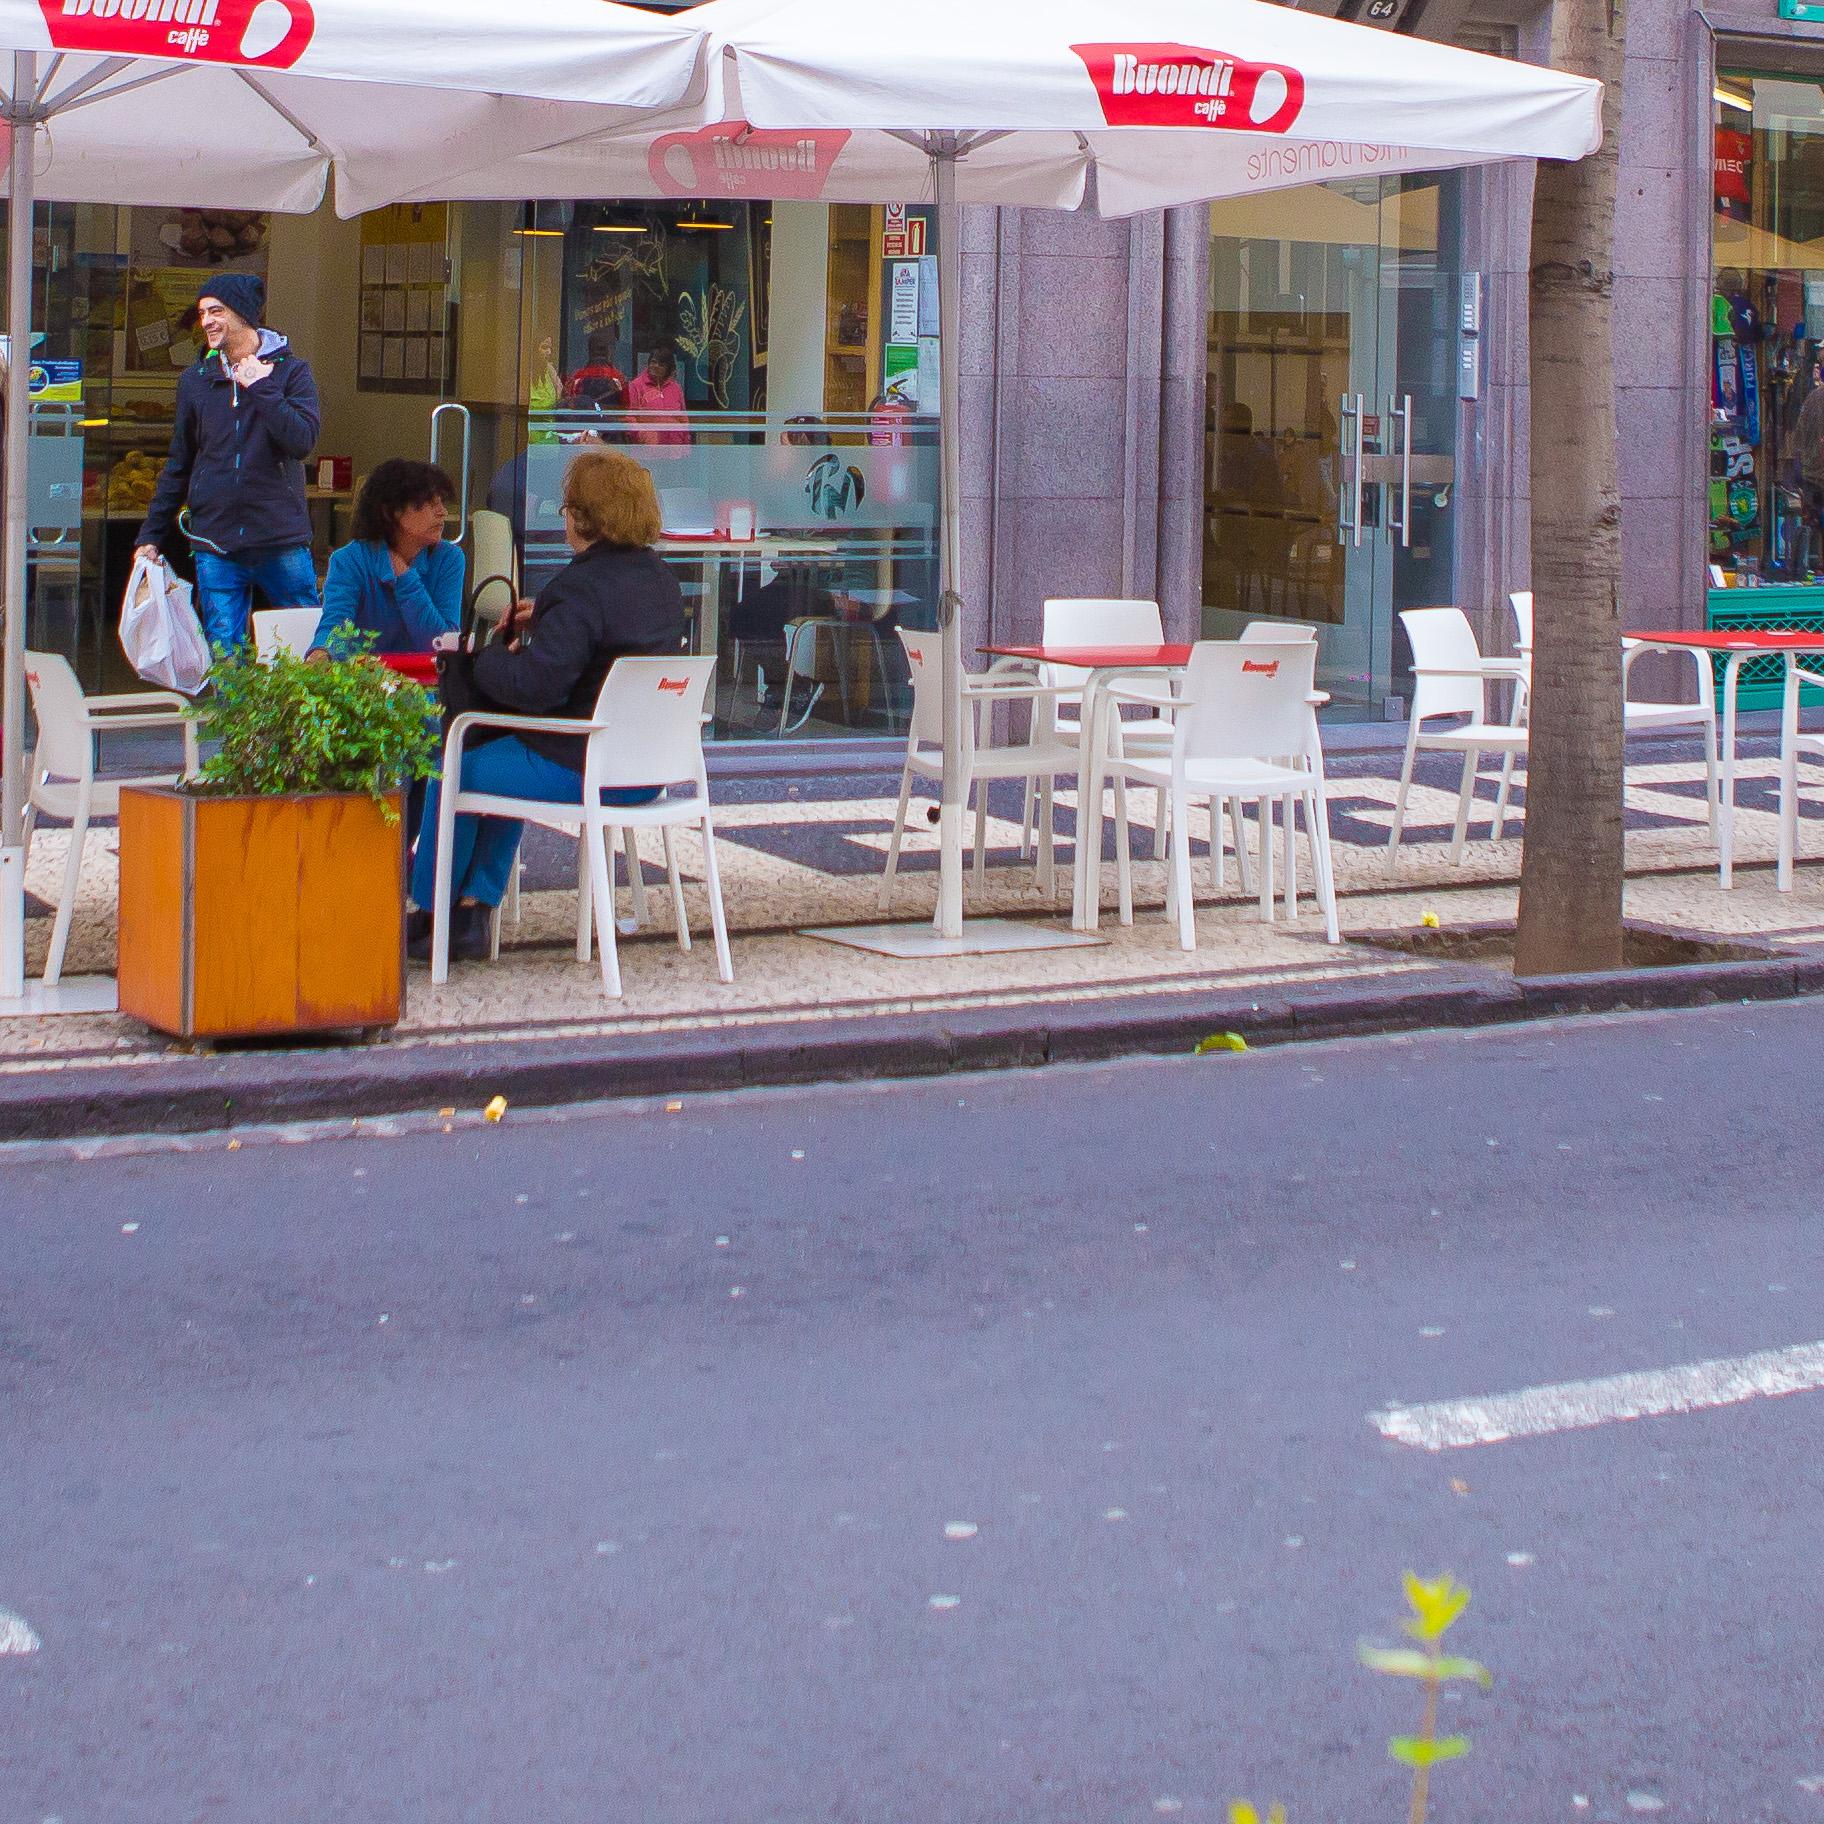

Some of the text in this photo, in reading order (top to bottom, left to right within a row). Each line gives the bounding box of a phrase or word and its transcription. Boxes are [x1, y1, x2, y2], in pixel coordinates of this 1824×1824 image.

[1370, 1, 1394, 17] 64
[167, 28, 209, 53] caffè
[1113, 53, 1233, 96] Buondi
[1194, 99, 1227, 122] caffè
